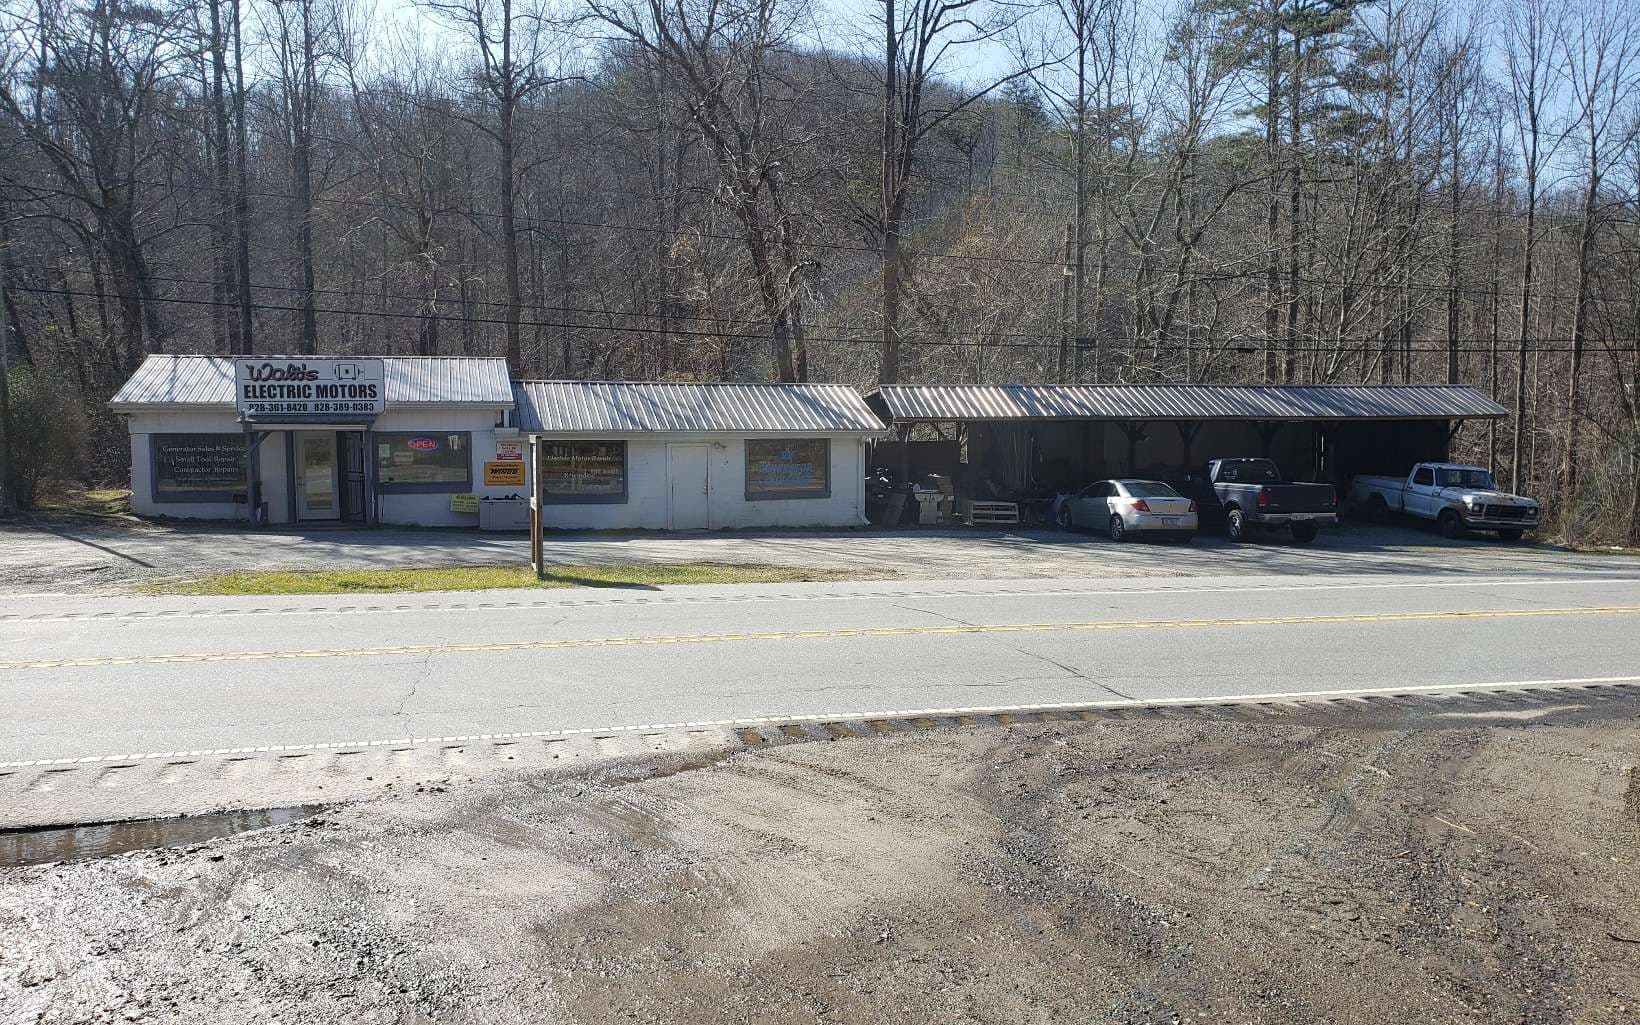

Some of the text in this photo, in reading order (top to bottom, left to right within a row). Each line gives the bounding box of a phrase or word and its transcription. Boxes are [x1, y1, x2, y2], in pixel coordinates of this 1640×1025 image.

[246, 363, 320, 382] Walt's
[243, 384, 378, 399] ELECTRIC MOTORS
[248, 402, 375, 412] 828-361-8420 828-389-0383
[408, 440, 436, 449] OPEN
